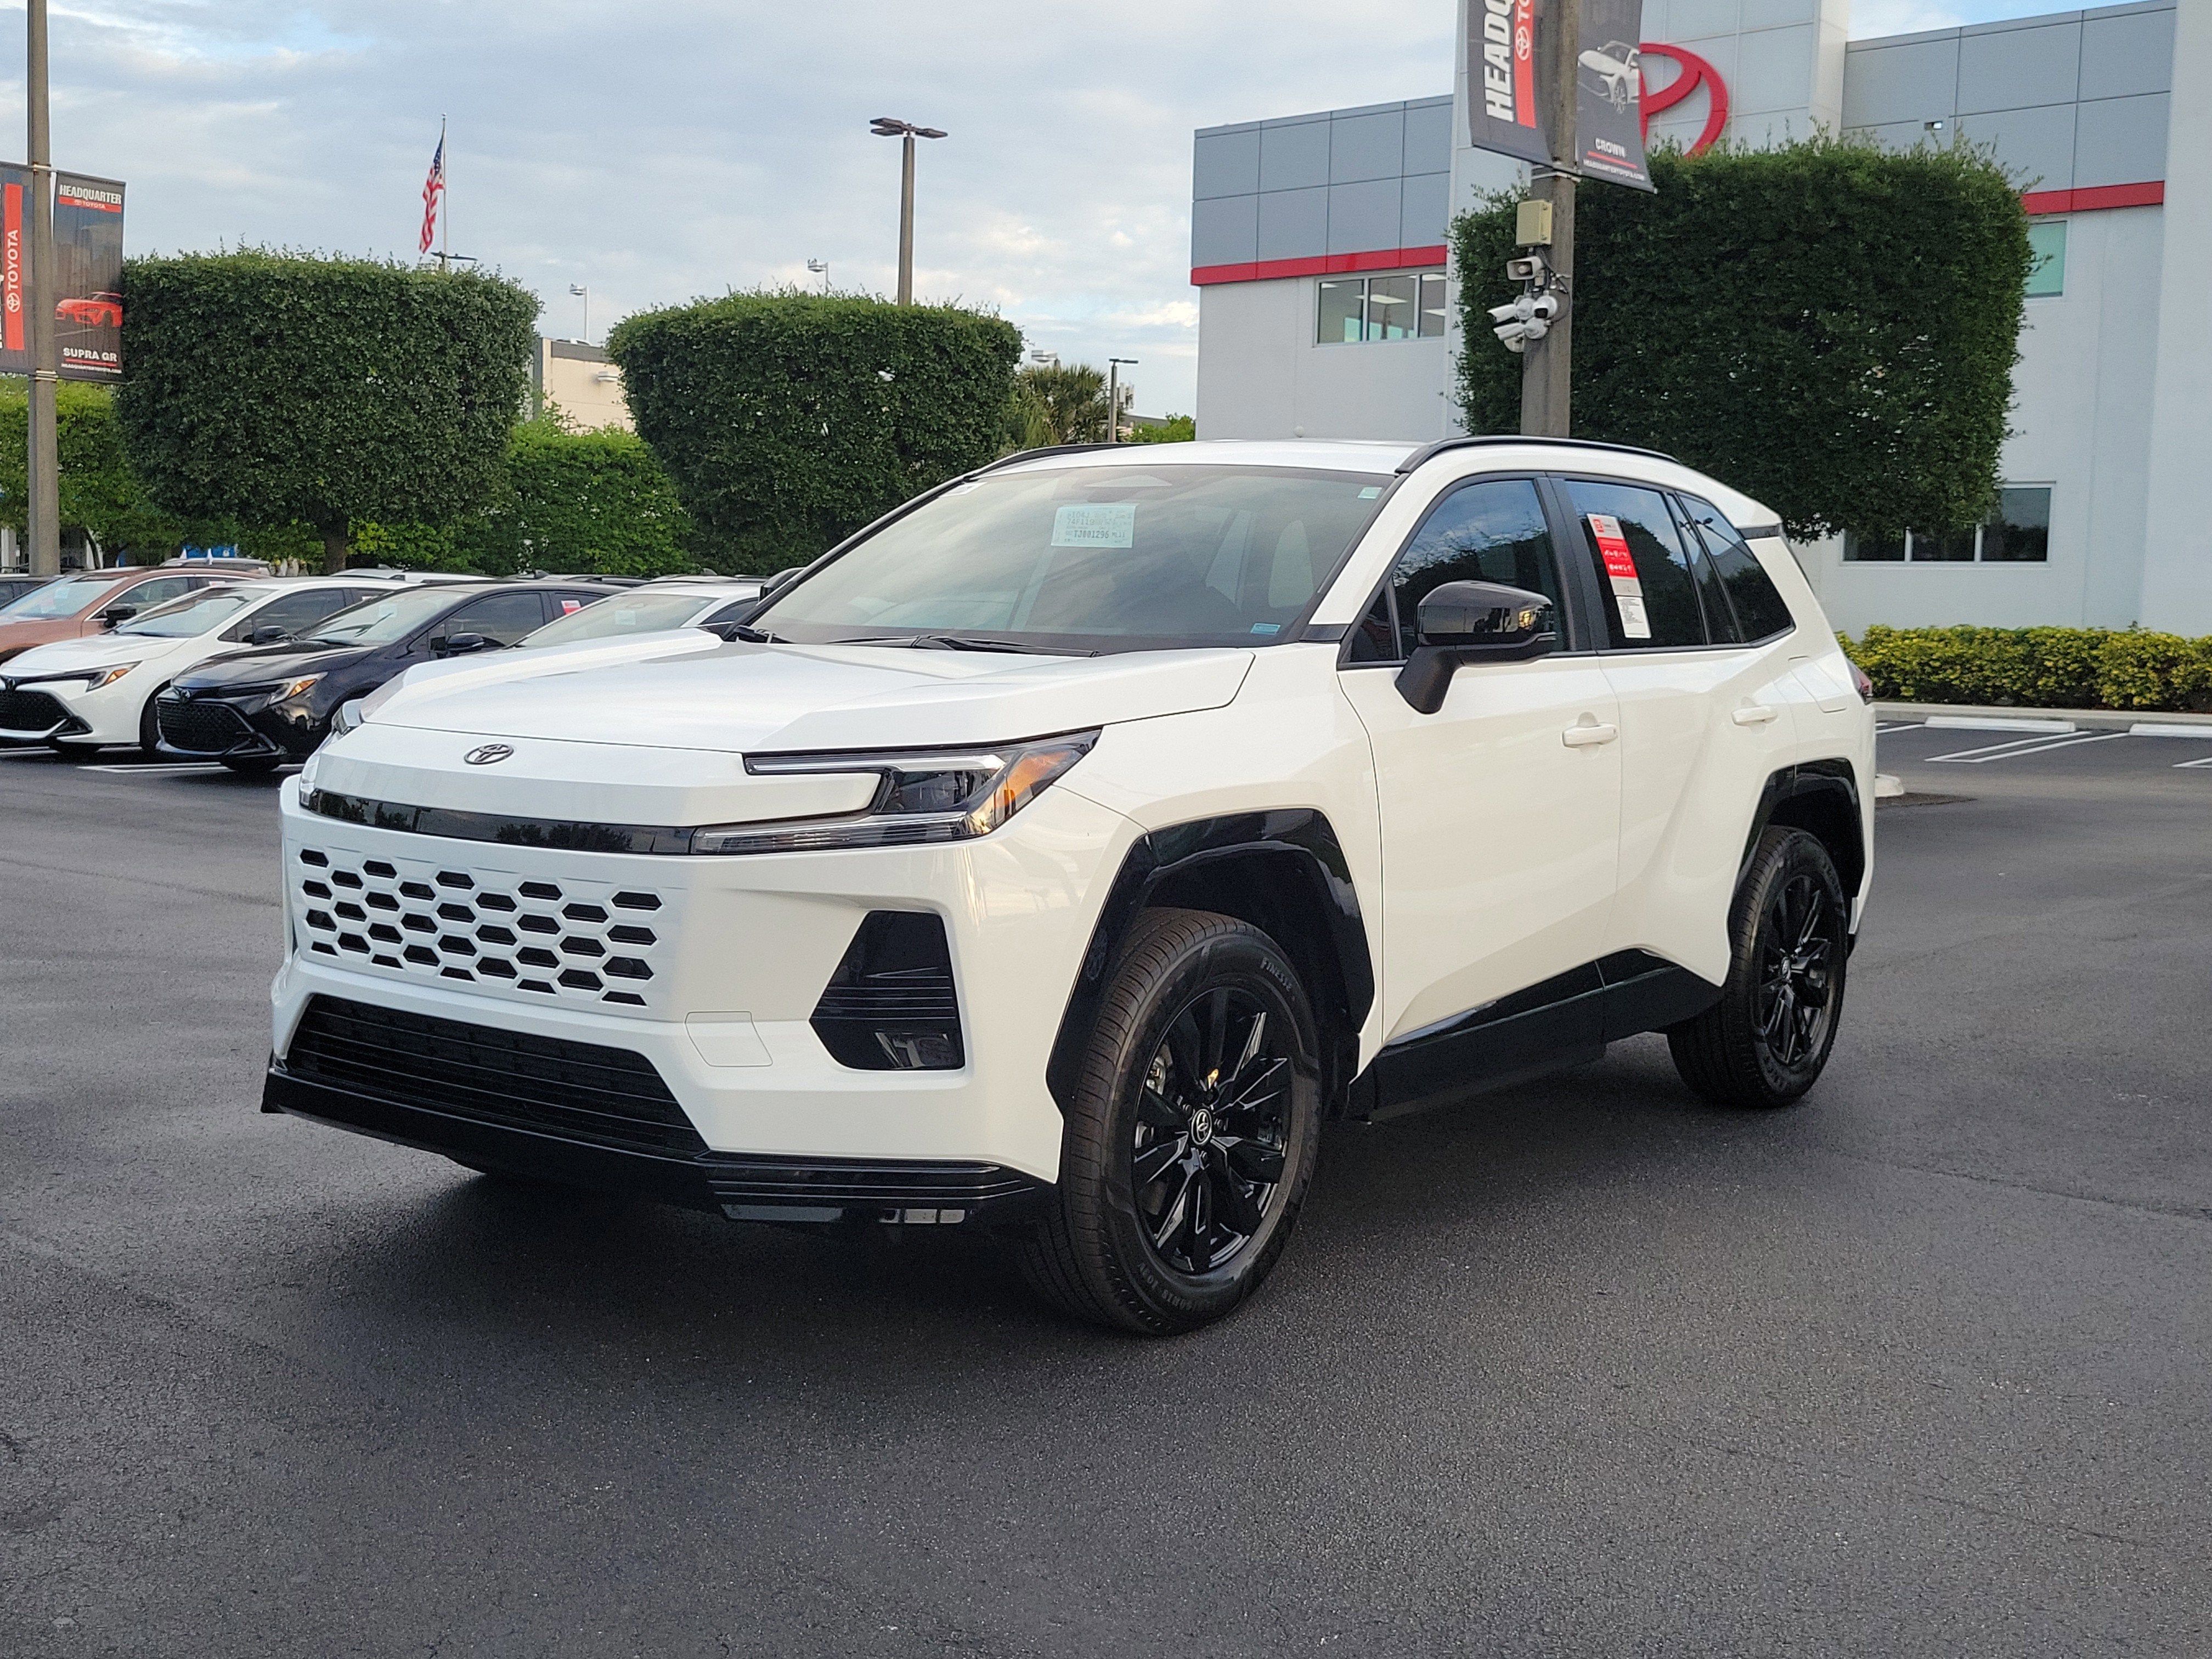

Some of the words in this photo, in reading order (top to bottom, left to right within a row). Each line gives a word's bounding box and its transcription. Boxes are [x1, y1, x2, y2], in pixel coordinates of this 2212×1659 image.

[1594, 138, 1626, 158] CROWN
[59, 184, 122, 205] HEADQUARTER
[82, 200, 106, 209] TOYOTA
[7, 229, 19, 291] TOYOTA
[63, 347, 100, 360] SUPRA
[101, 349, 117, 362] GR
